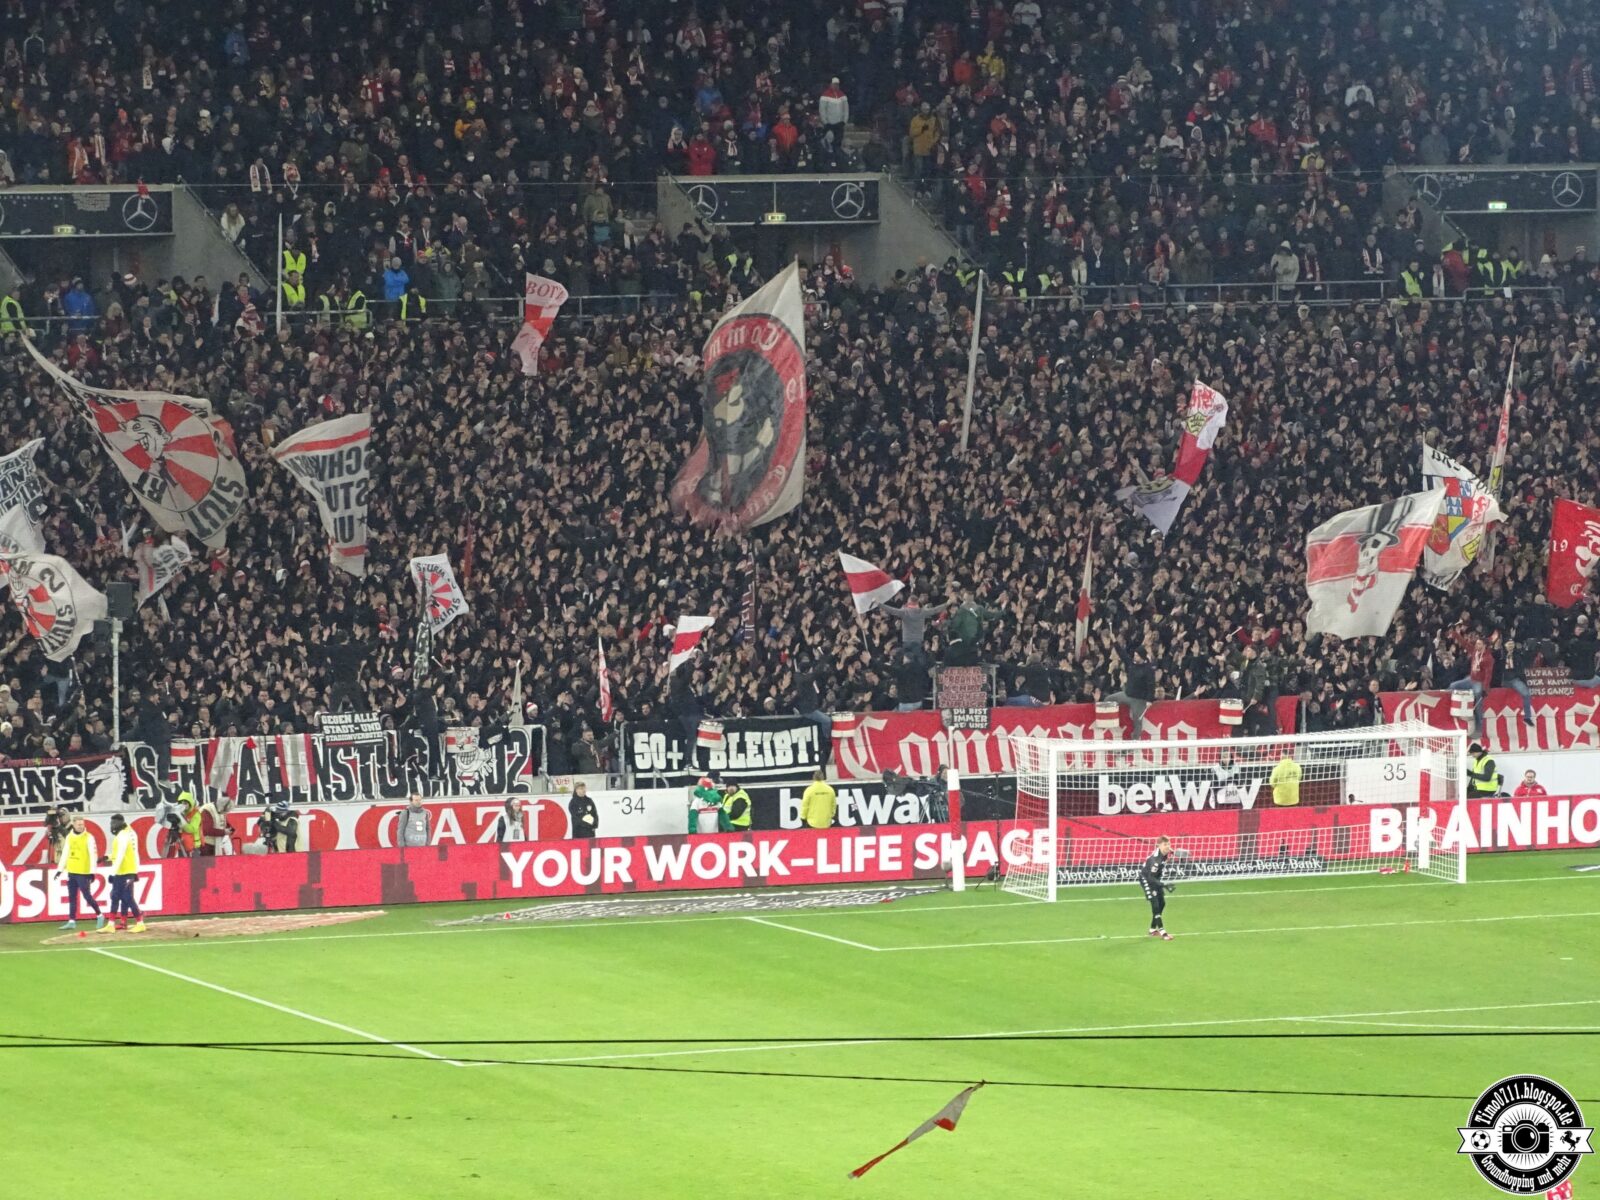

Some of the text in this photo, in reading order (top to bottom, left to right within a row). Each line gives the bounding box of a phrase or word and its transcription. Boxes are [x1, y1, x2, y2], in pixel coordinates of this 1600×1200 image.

[321, 712, 379, 725] GEGEN ALLE
[323, 722, 381, 734] STADT- UND
[1383, 763, 1407, 781] 35
[1098, 774, 1263, 815] betwy
[501, 847, 633, 889] YOUR
[643, 833, 903, 882] WORK-LIFE
[1194, 857, 1322, 875] Mercedes-Benz Bank
